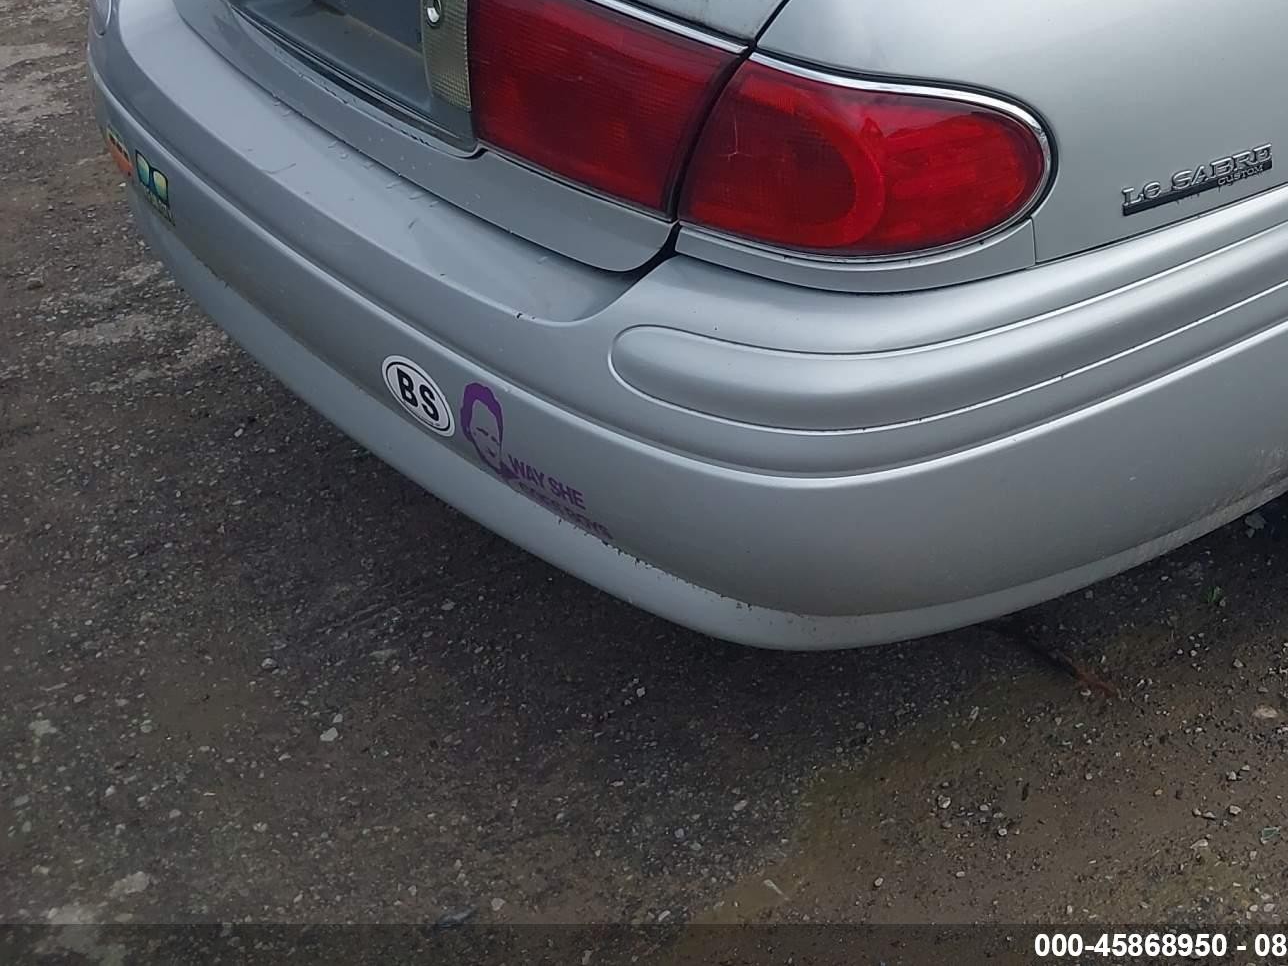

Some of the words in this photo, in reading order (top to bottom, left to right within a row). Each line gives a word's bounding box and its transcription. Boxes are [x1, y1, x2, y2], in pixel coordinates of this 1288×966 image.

[1218, 165, 1264, 186] CUSTOM
[396, 367, 440, 422] BS
[507, 454, 546, 489] WAY
[547, 476, 587, 510] SHE
